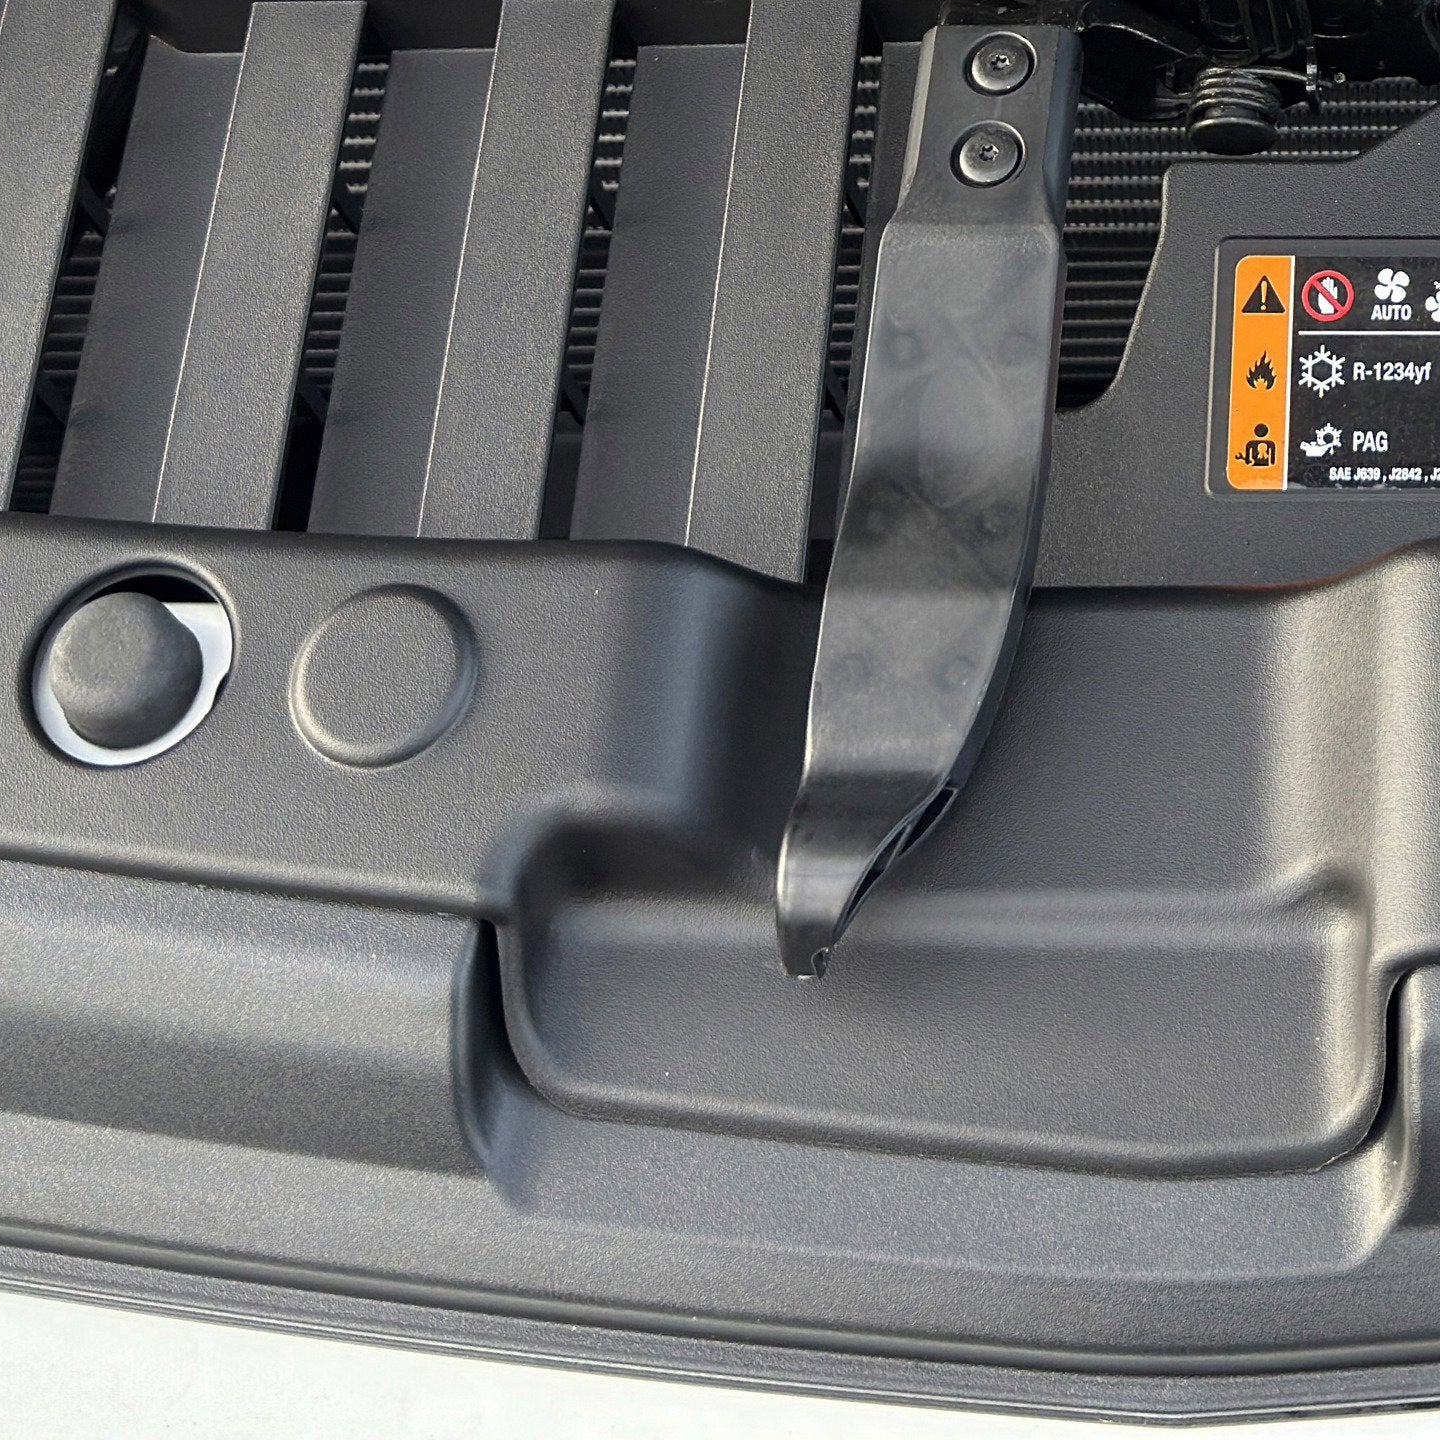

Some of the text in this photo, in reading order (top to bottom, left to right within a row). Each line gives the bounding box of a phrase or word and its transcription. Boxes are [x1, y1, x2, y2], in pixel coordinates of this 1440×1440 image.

[1371, 304, 1412, 321] AUTO
[1353, 362, 1432, 385] R-1234yf
[1352, 431, 1388, 452] PAG
[1329, 467, 1351, 481] SAE
